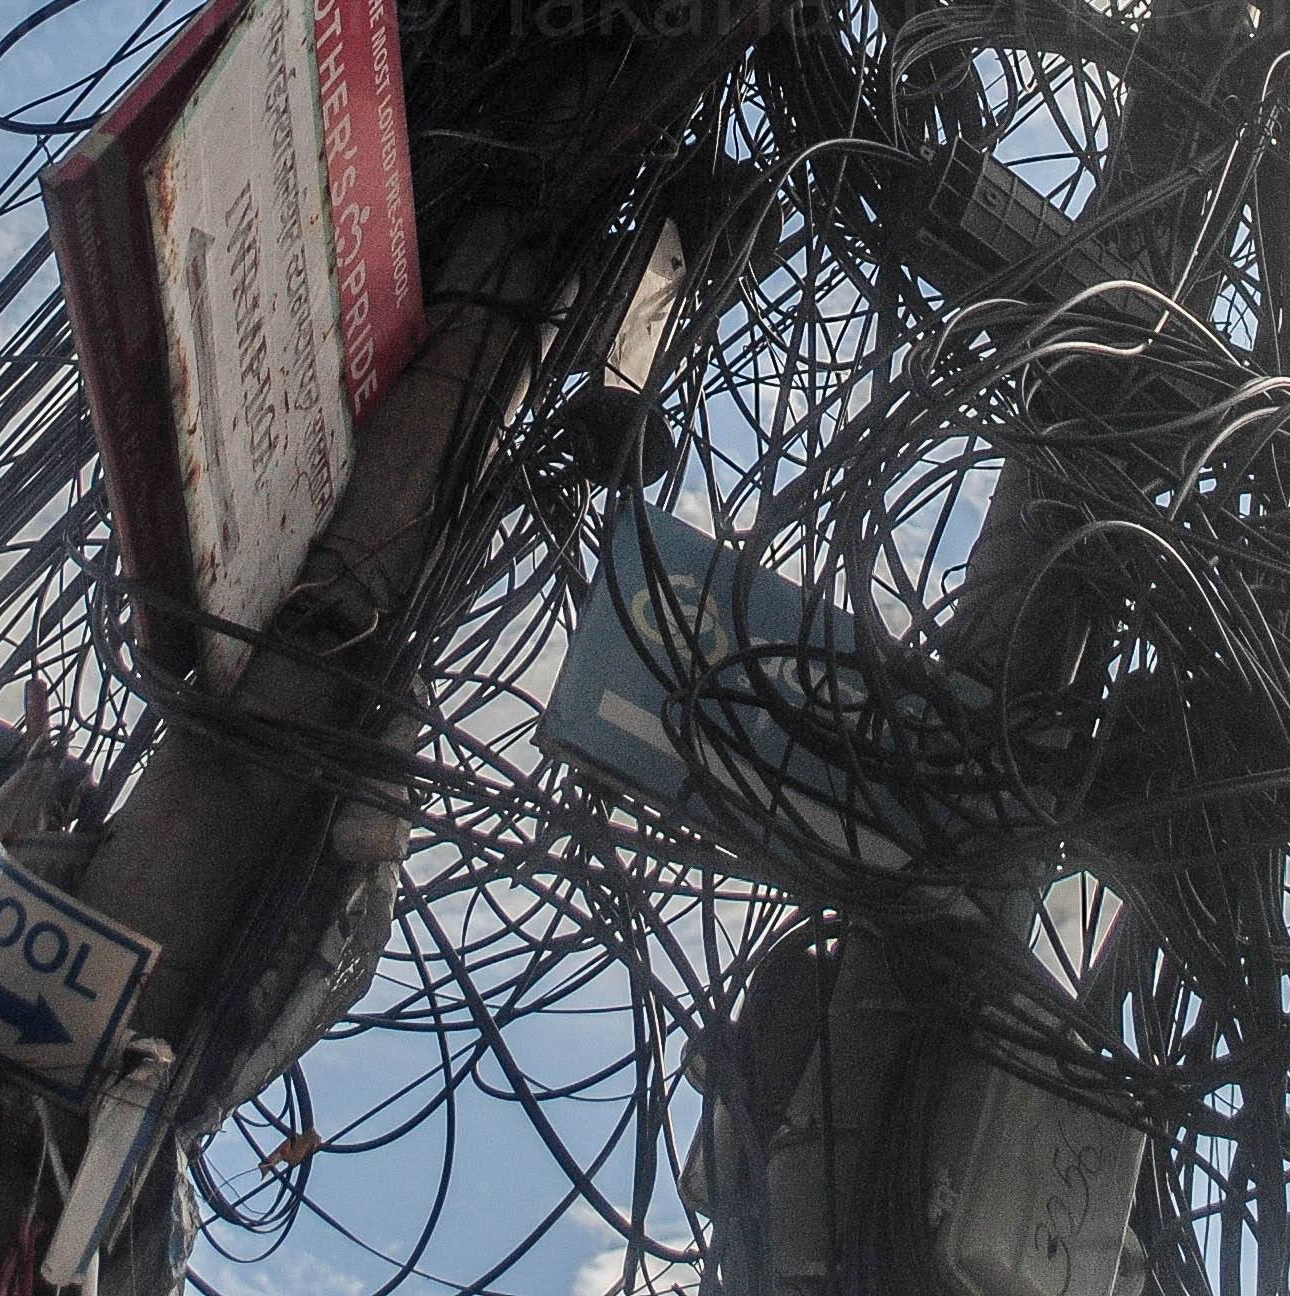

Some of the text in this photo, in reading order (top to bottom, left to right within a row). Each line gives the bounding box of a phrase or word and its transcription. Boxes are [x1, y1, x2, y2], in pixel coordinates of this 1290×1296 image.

[371, 25, 391, 96] MOST
[378, 94, 397, 172] LOVED
[384, 170, 410, 309] PRE-SCHOOL
[341, 258, 378, 416] PRIDE
